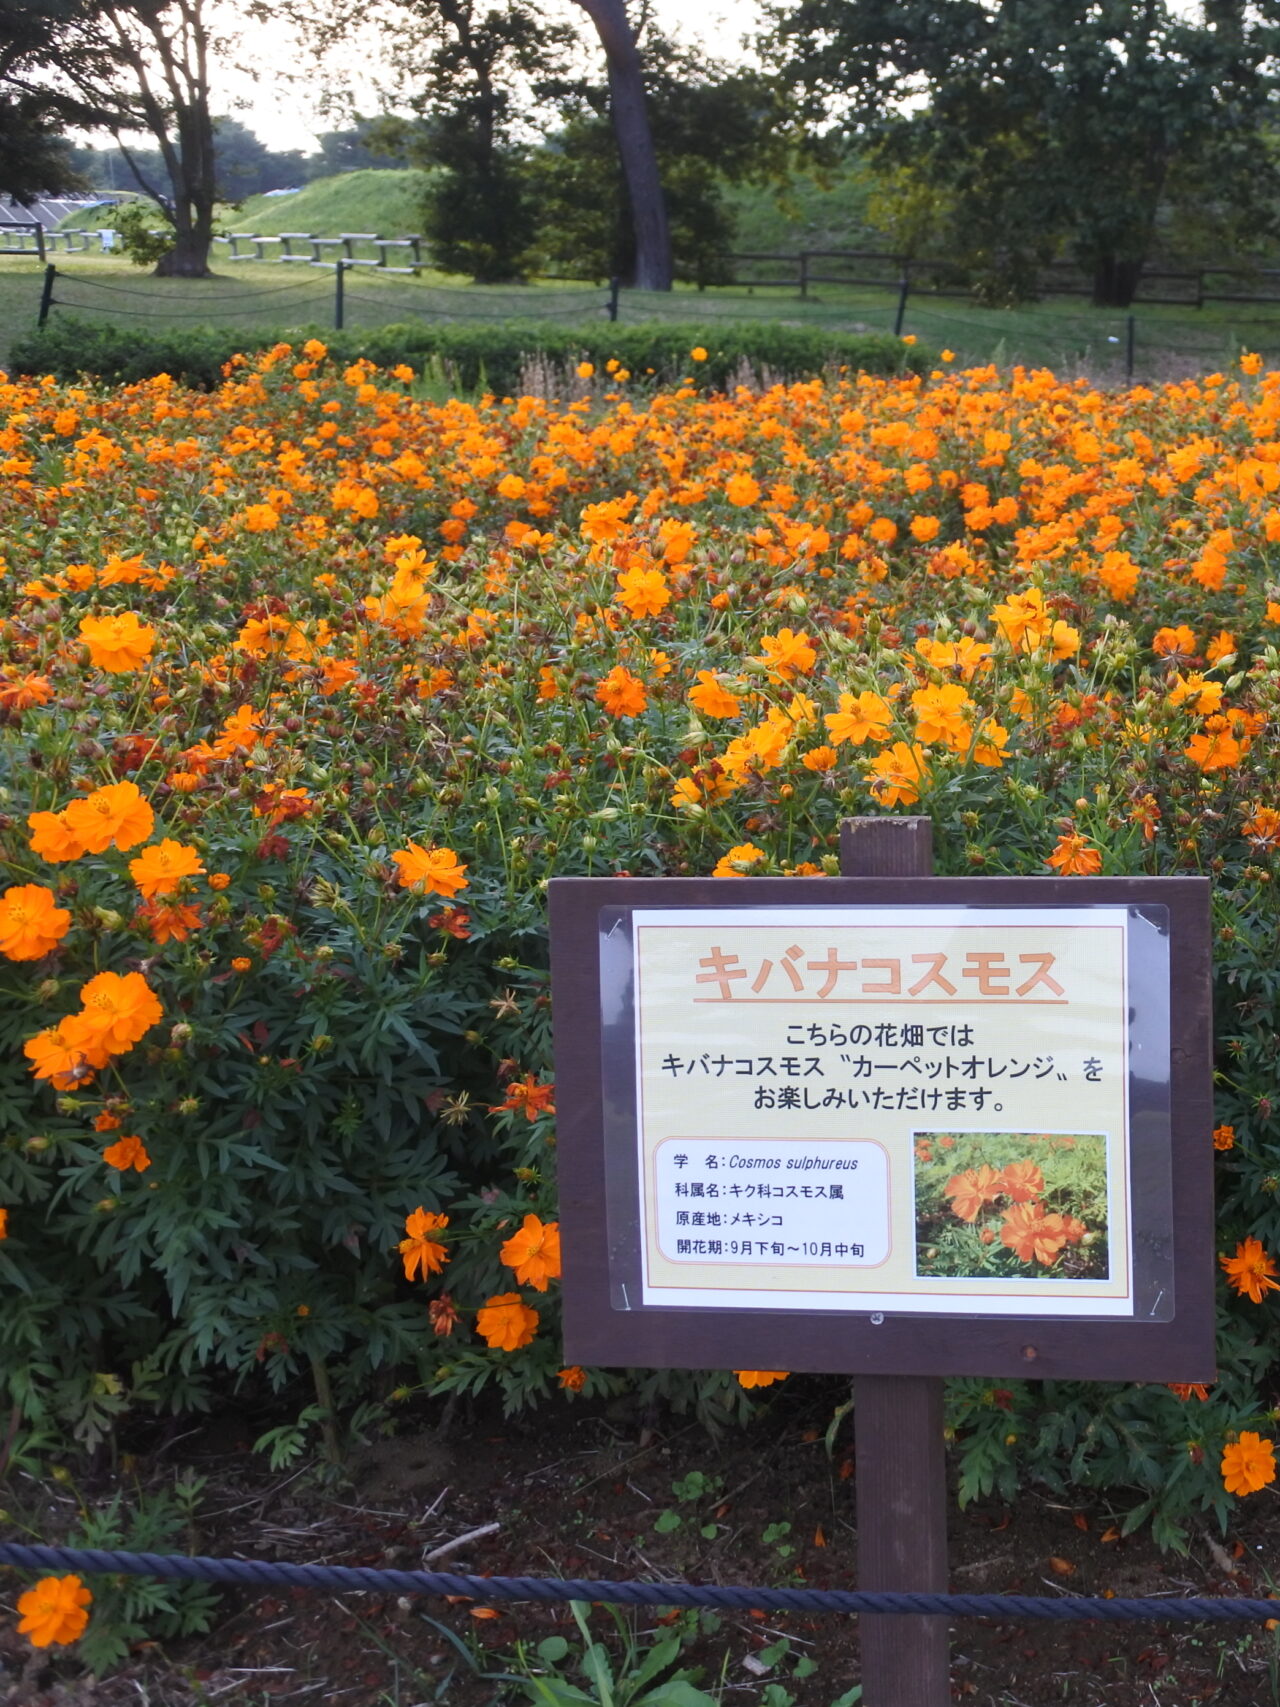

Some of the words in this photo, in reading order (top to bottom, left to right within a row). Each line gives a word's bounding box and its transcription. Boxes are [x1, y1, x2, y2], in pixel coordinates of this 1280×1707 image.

[695, 944, 1065, 999] キバナコスモス
[786, 1022, 975, 1048] こちらの花畑では
[754, 1085, 1003, 1112] お楽しみいただけます。
[787, 1156, 859, 1172] sulphureus
